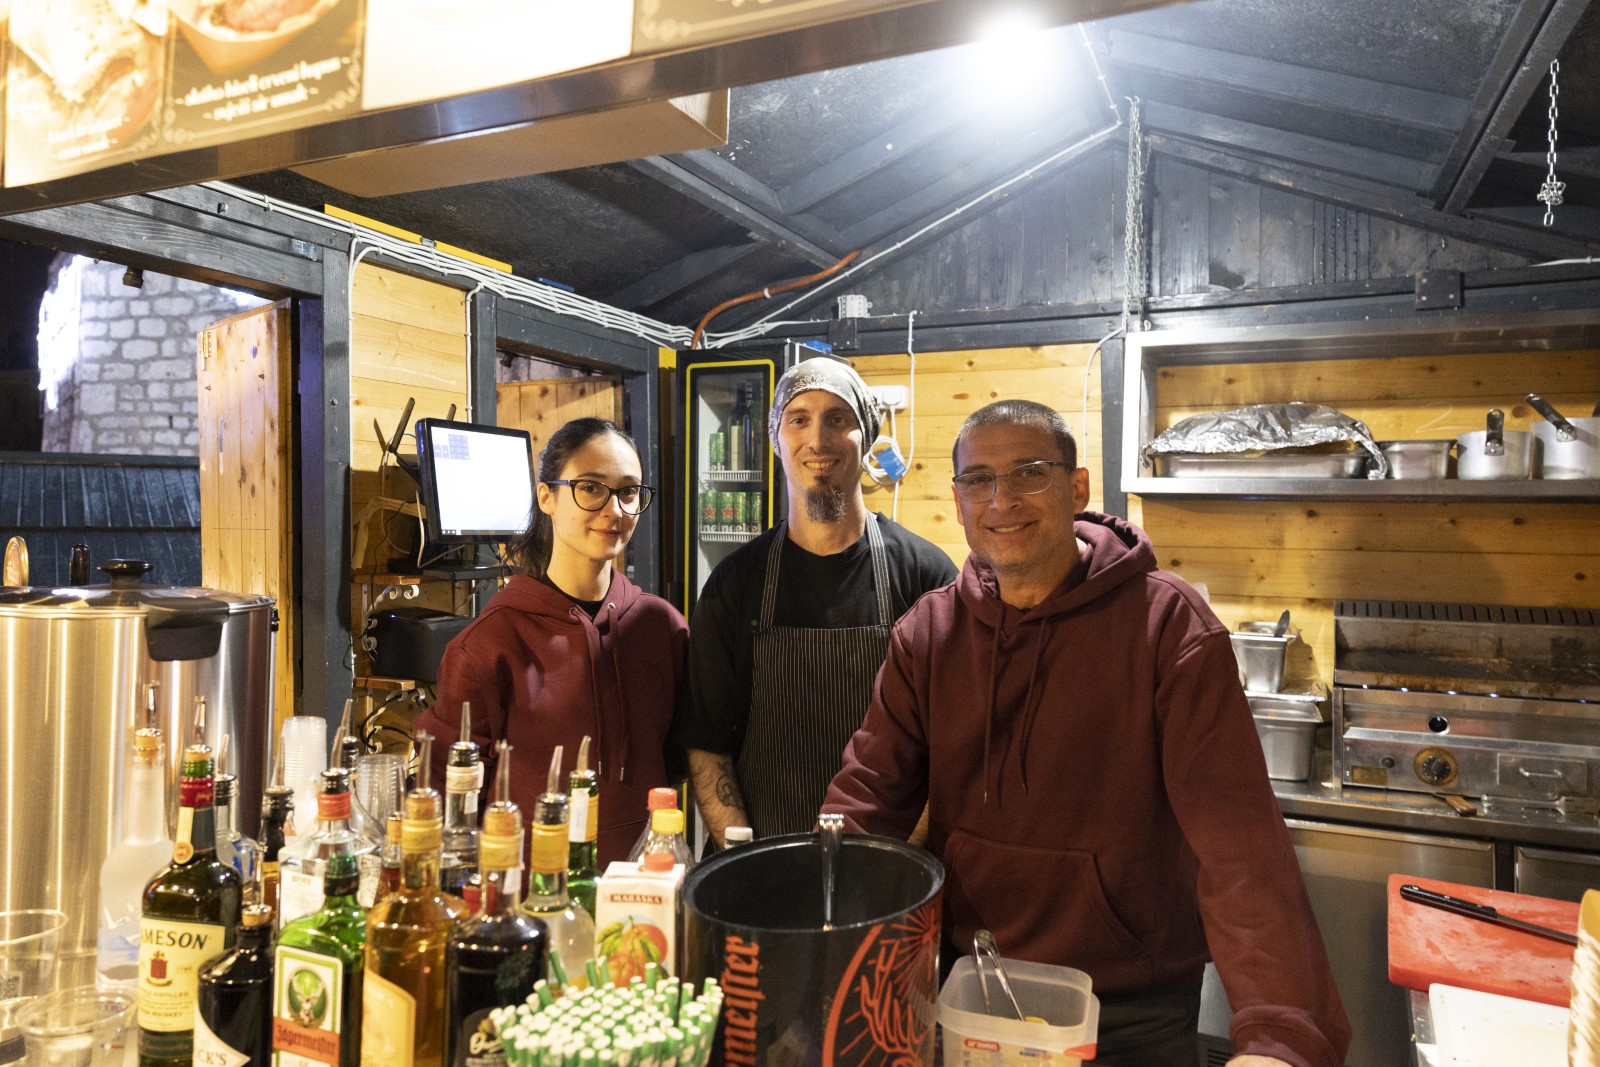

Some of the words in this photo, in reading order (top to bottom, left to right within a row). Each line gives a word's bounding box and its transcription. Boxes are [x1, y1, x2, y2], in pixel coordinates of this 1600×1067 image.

[224, 75, 258, 97] kiseli
[140, 928, 208, 951] MESON
[720, 935, 767, 1067] meister
[966, 1039, 998, 1051] araven
